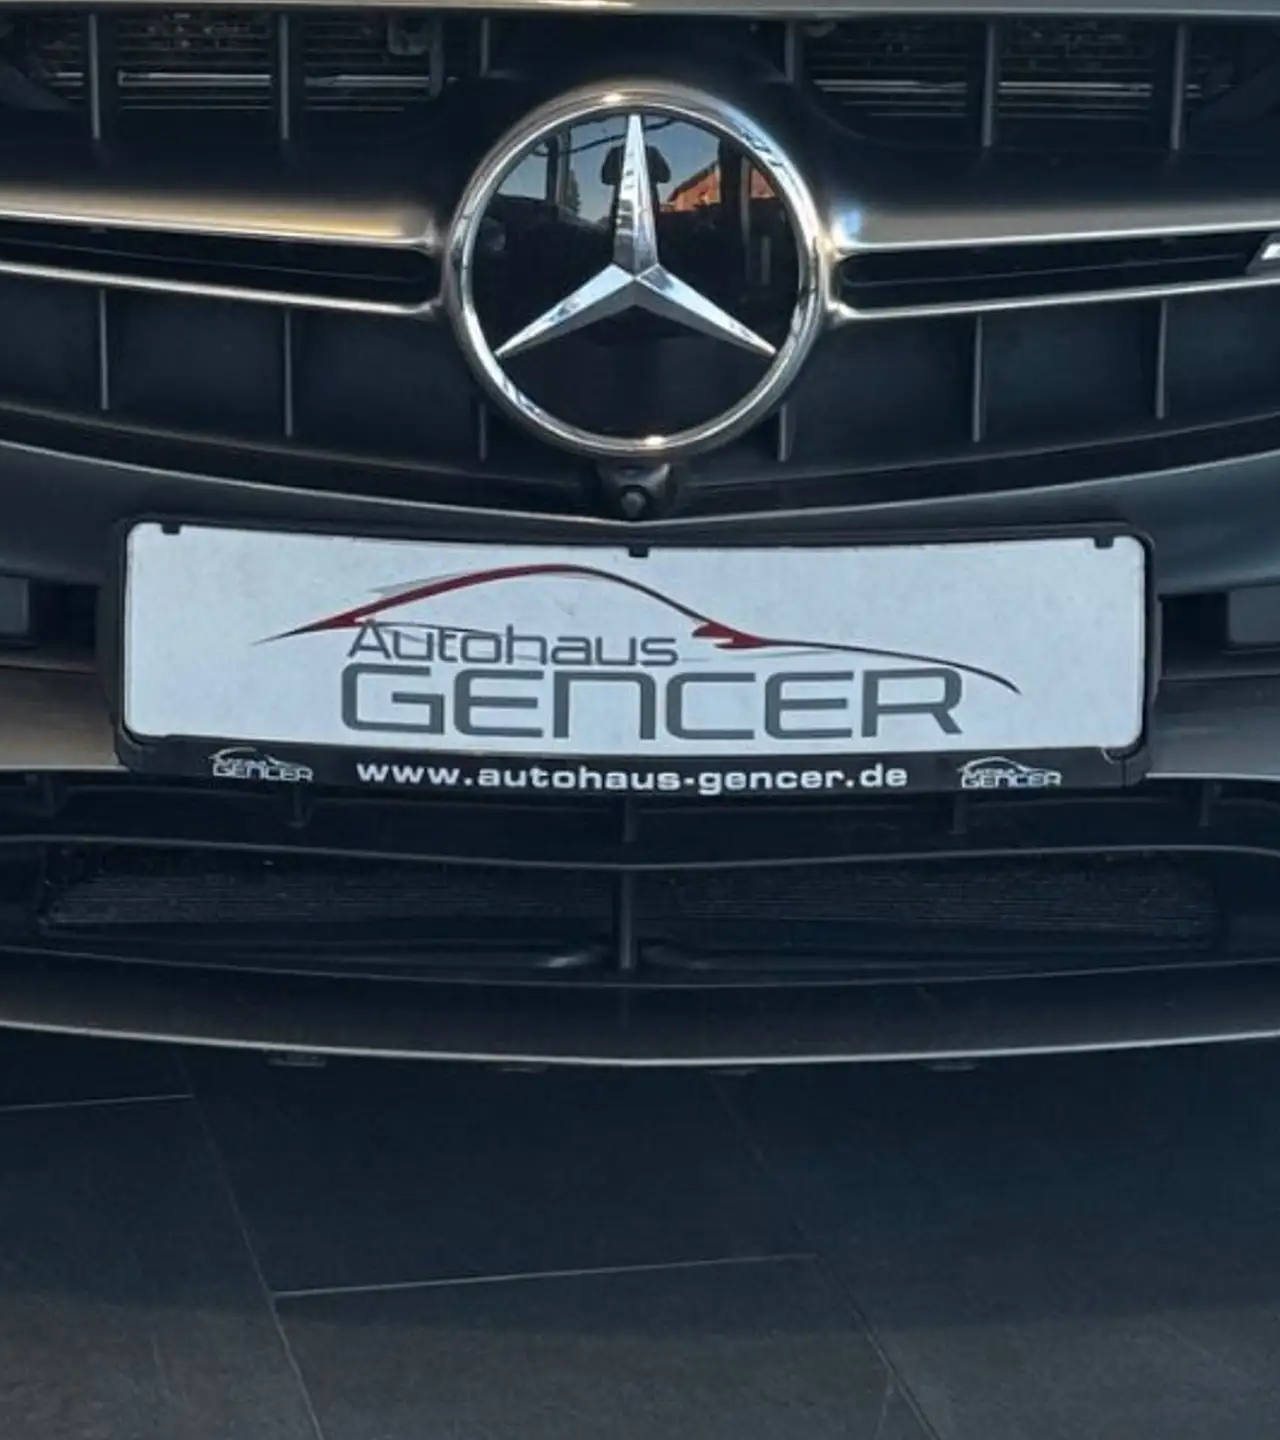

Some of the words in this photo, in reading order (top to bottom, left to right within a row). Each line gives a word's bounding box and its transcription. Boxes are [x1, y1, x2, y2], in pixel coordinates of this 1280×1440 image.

[347, 619, 678, 667] Autohaus
[341, 662, 963, 740] GENCER
[356, 762, 908, 796] www.autohaus-gencer.de
